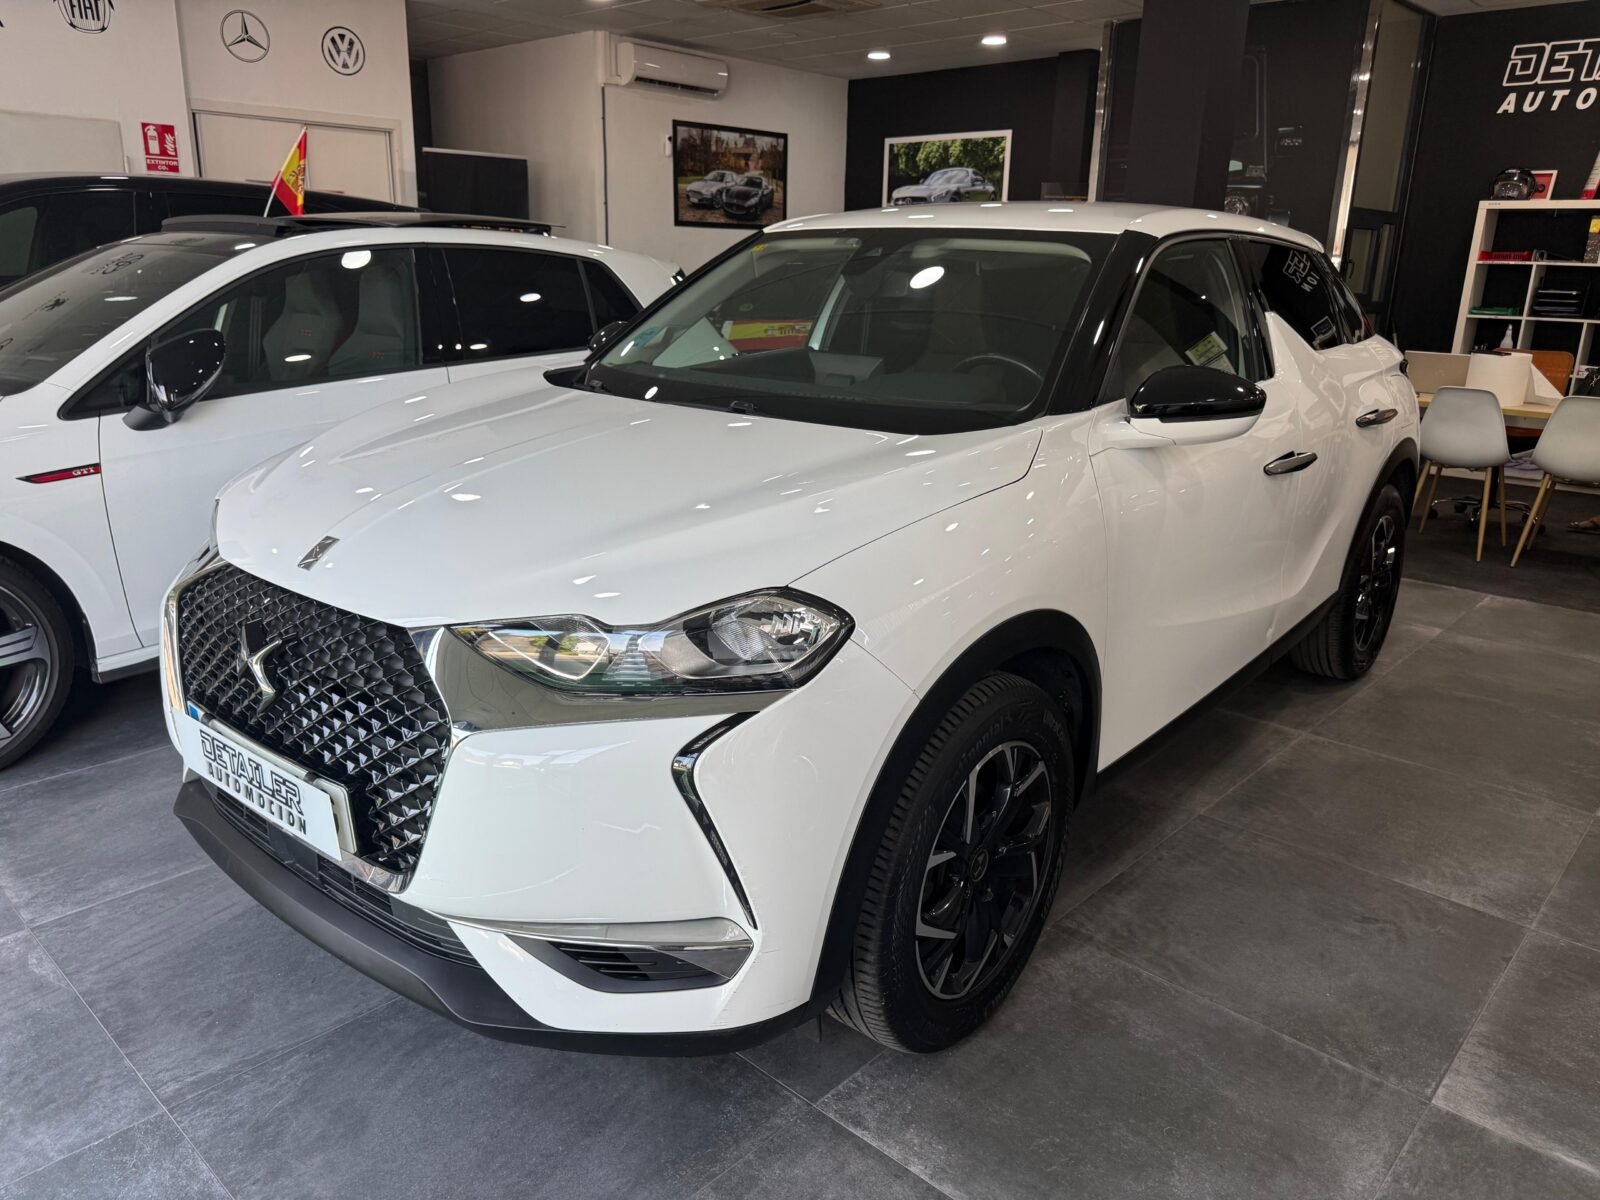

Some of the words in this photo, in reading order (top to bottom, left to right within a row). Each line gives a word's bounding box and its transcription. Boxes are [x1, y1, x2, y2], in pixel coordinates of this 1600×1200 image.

[69, 0, 101, 21] FIAT
[1503, 37, 1600, 86] DET
[146, 158, 178, 166] EXTINTOR
[71, 466, 96, 477] GTI
[199, 729, 305, 817] DETAILER
